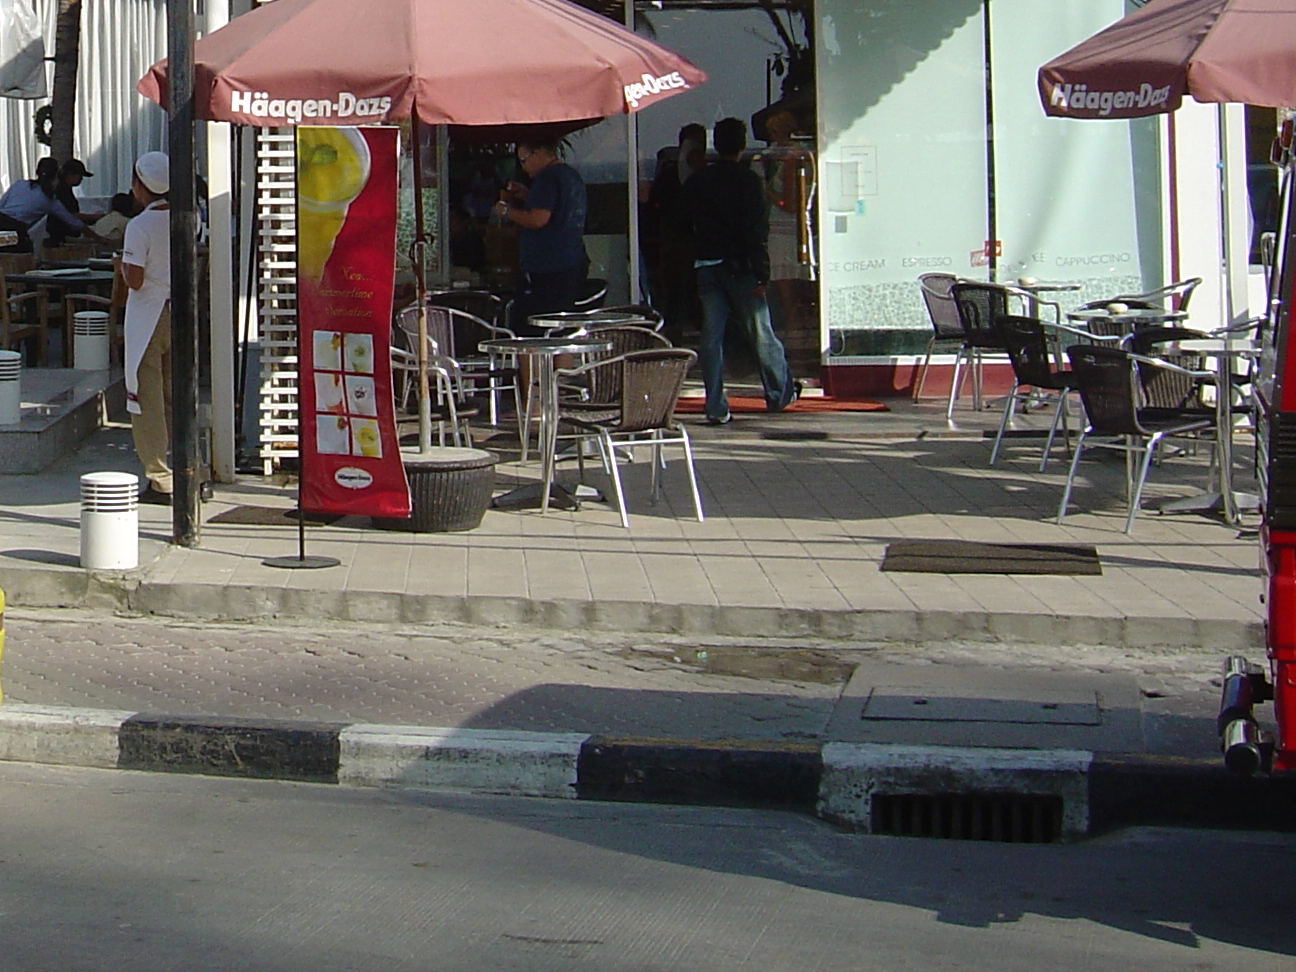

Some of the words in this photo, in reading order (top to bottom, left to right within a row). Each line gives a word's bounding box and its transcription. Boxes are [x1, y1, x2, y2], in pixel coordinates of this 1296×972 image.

[231, 91, 392, 124] Häagen-Dazs
[844, 258, 885, 272] CREAM
[902, 256, 952, 268] ESPRESSO
[1055, 252, 1131, 267] CAPPUCCINO
